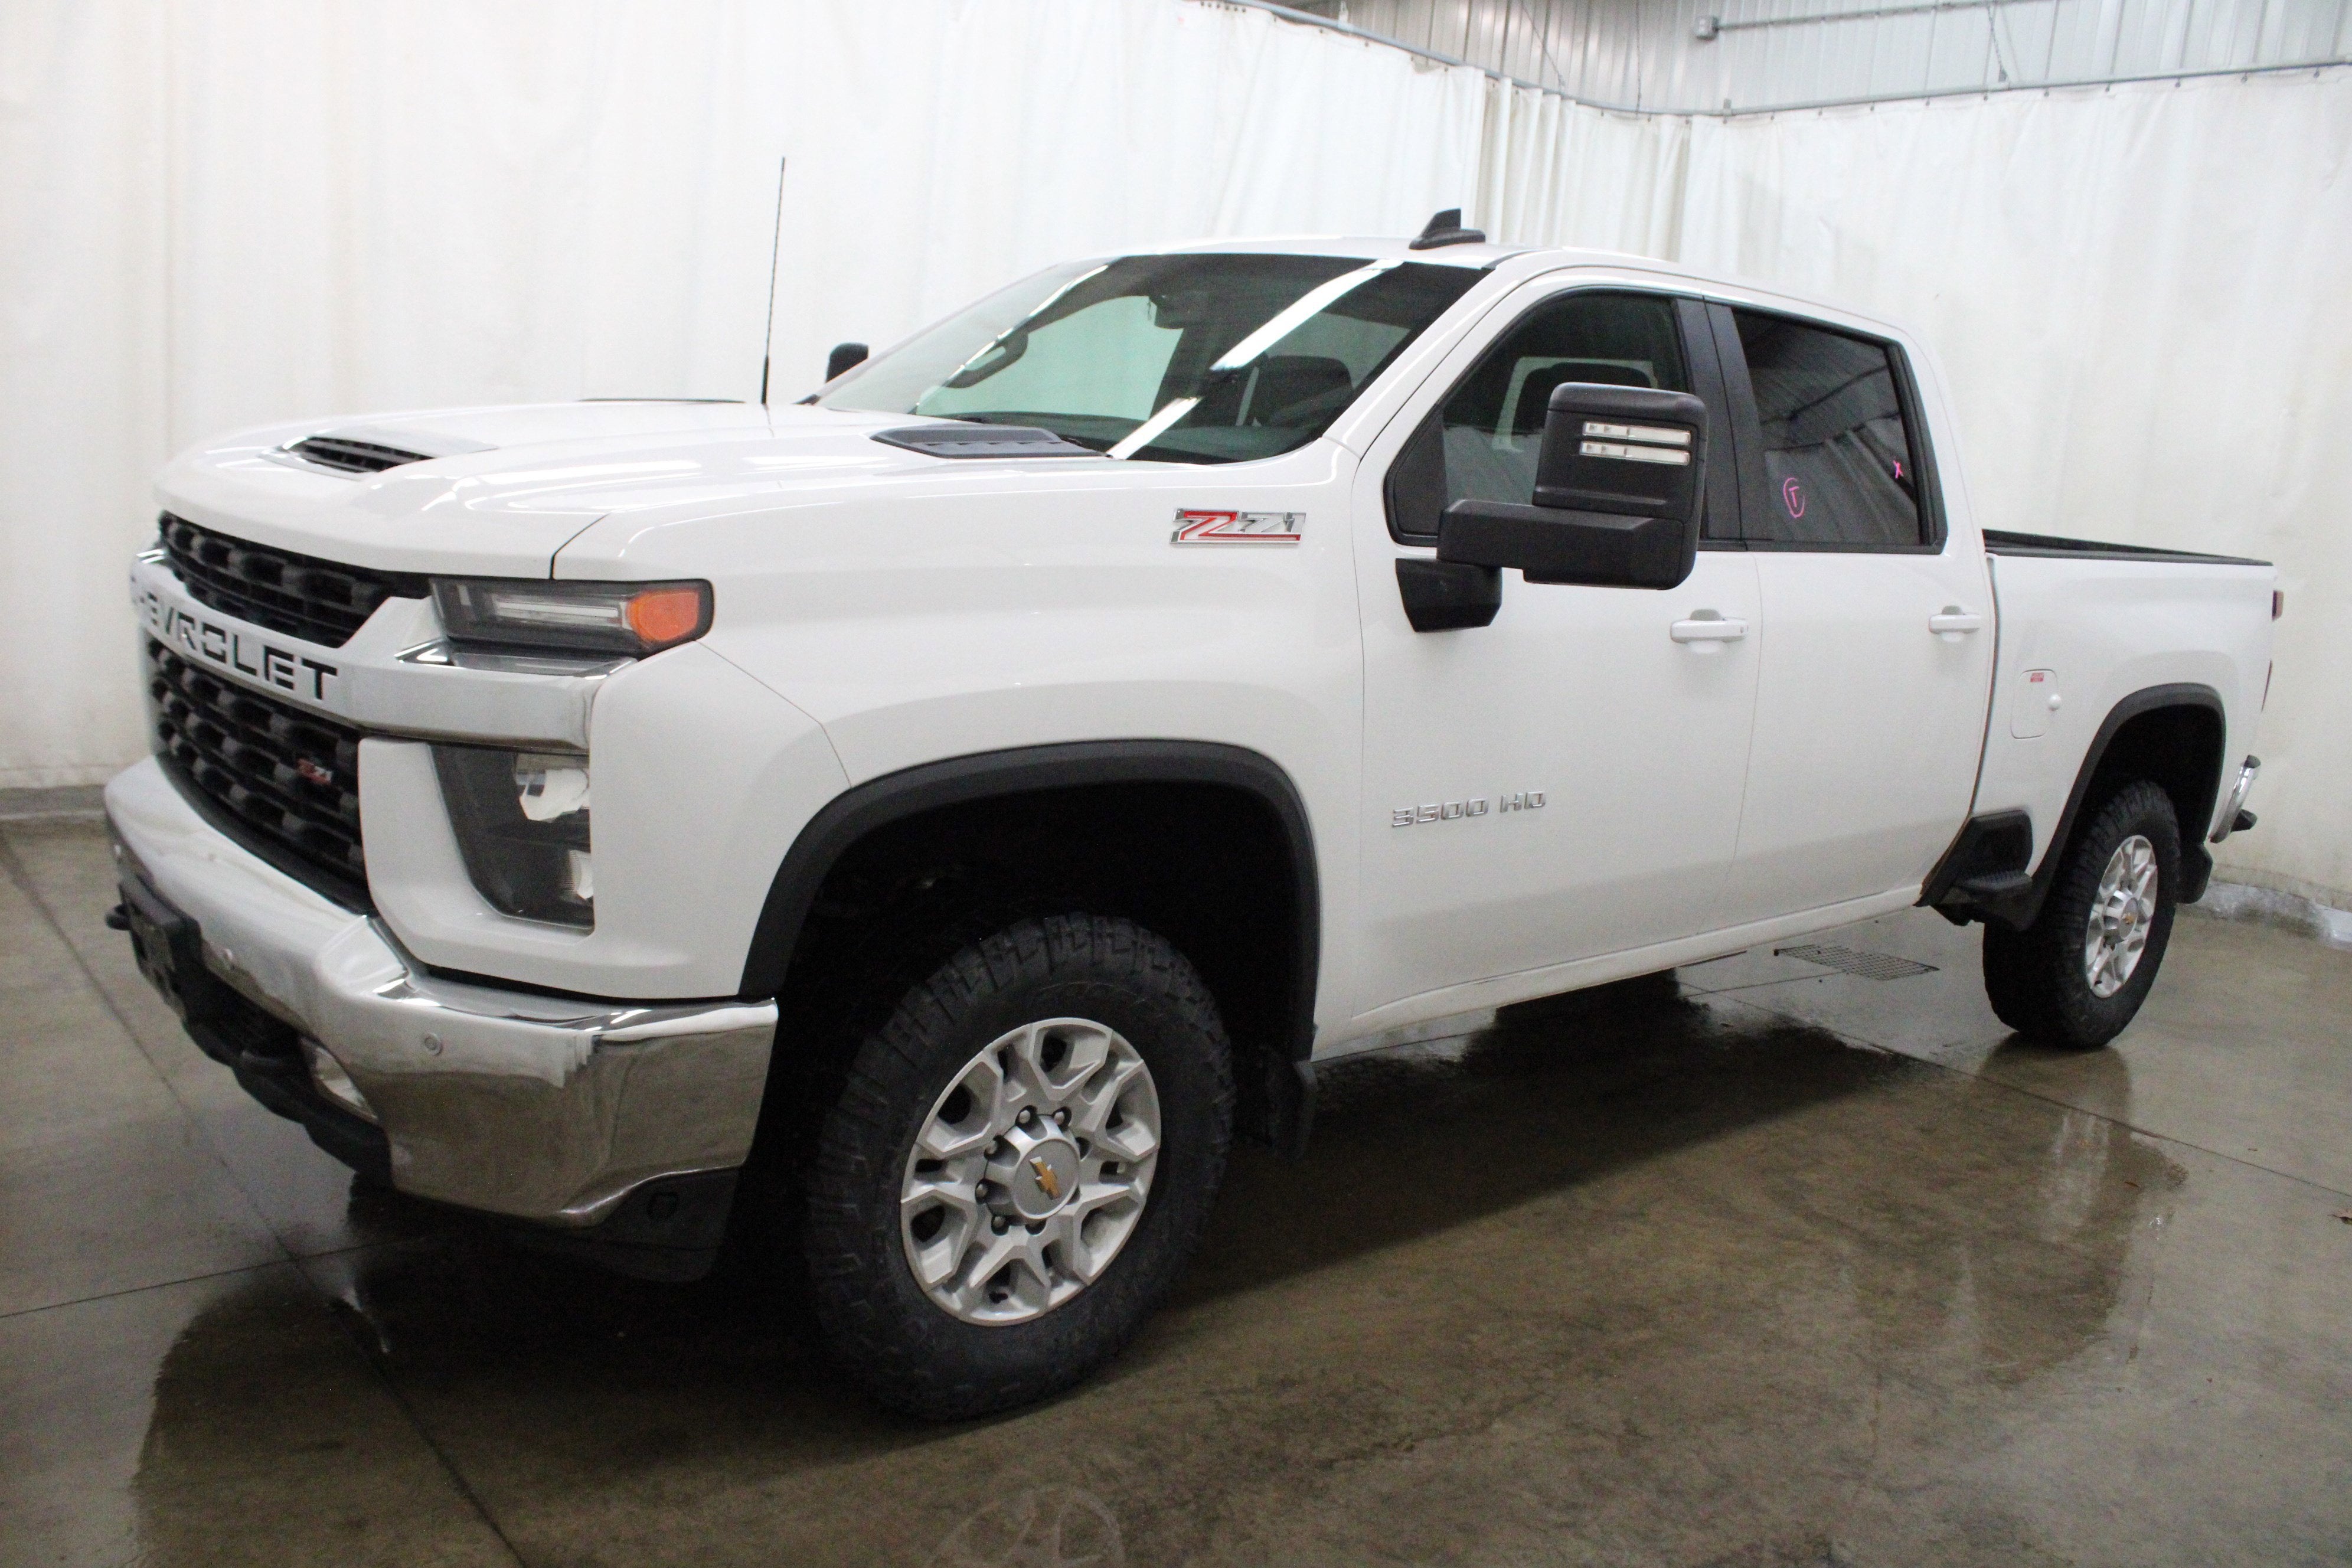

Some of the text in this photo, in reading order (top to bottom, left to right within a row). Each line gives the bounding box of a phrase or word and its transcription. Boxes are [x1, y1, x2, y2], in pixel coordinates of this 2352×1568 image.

[1170, 508, 1306, 544] Z71
[130, 575, 338, 701] EVROLET
[1392, 790, 1546, 827] 3500 HD
